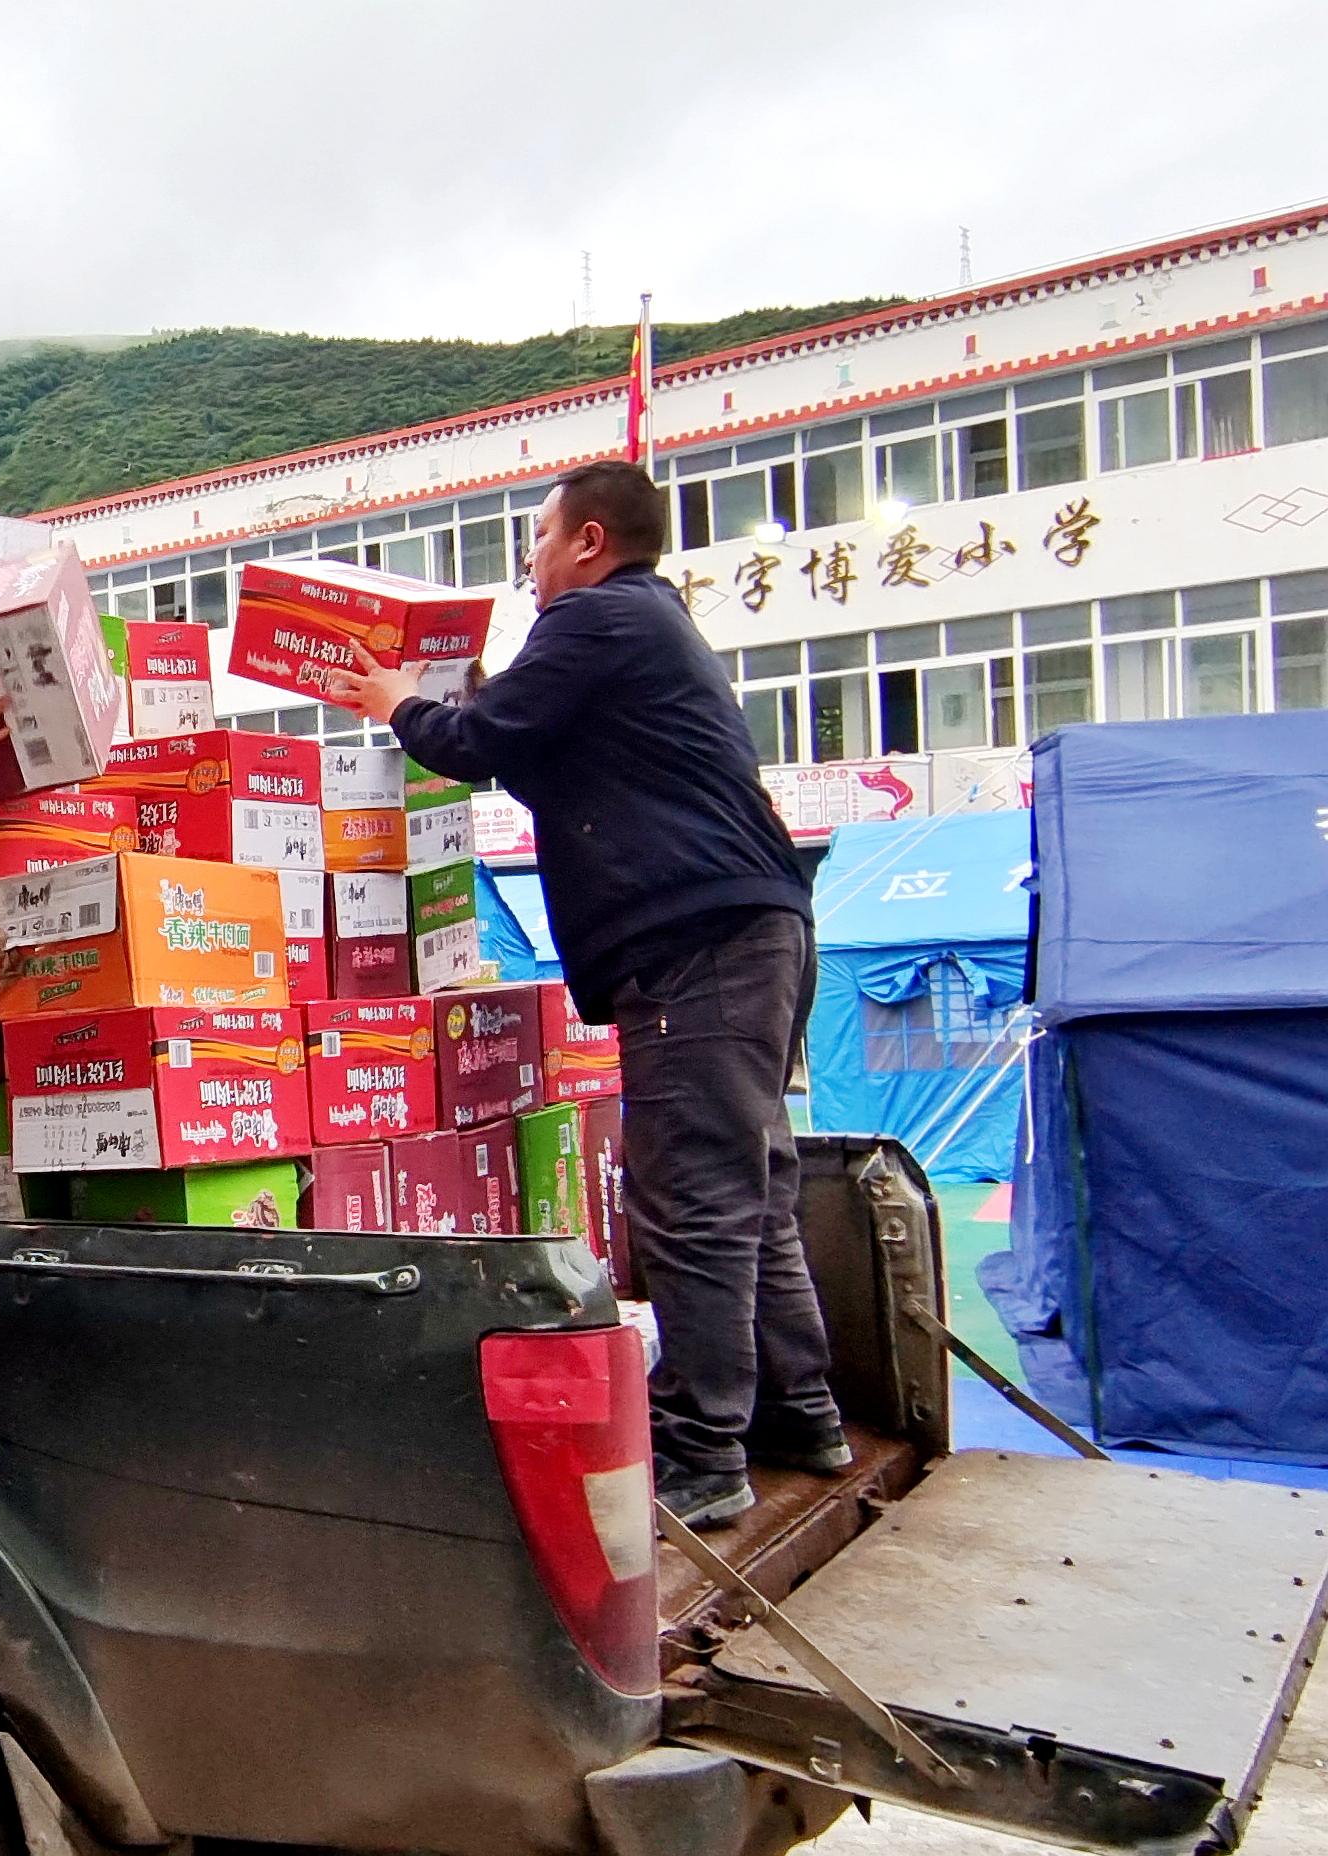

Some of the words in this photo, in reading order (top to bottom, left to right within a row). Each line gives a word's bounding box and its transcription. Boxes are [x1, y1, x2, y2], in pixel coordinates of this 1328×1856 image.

[273, 628, 354, 667] 红烧牛肉面
[248, 773, 304, 797] 红烧牛肉面
[158, 915, 251, 954] 香辣牛肉面
[35, 1059, 124, 1088] 红烧牛肉面
[346, 1065, 406, 1093] 红烧牛肉面
[199, 1079, 272, 1109] 红烧牛肉面
